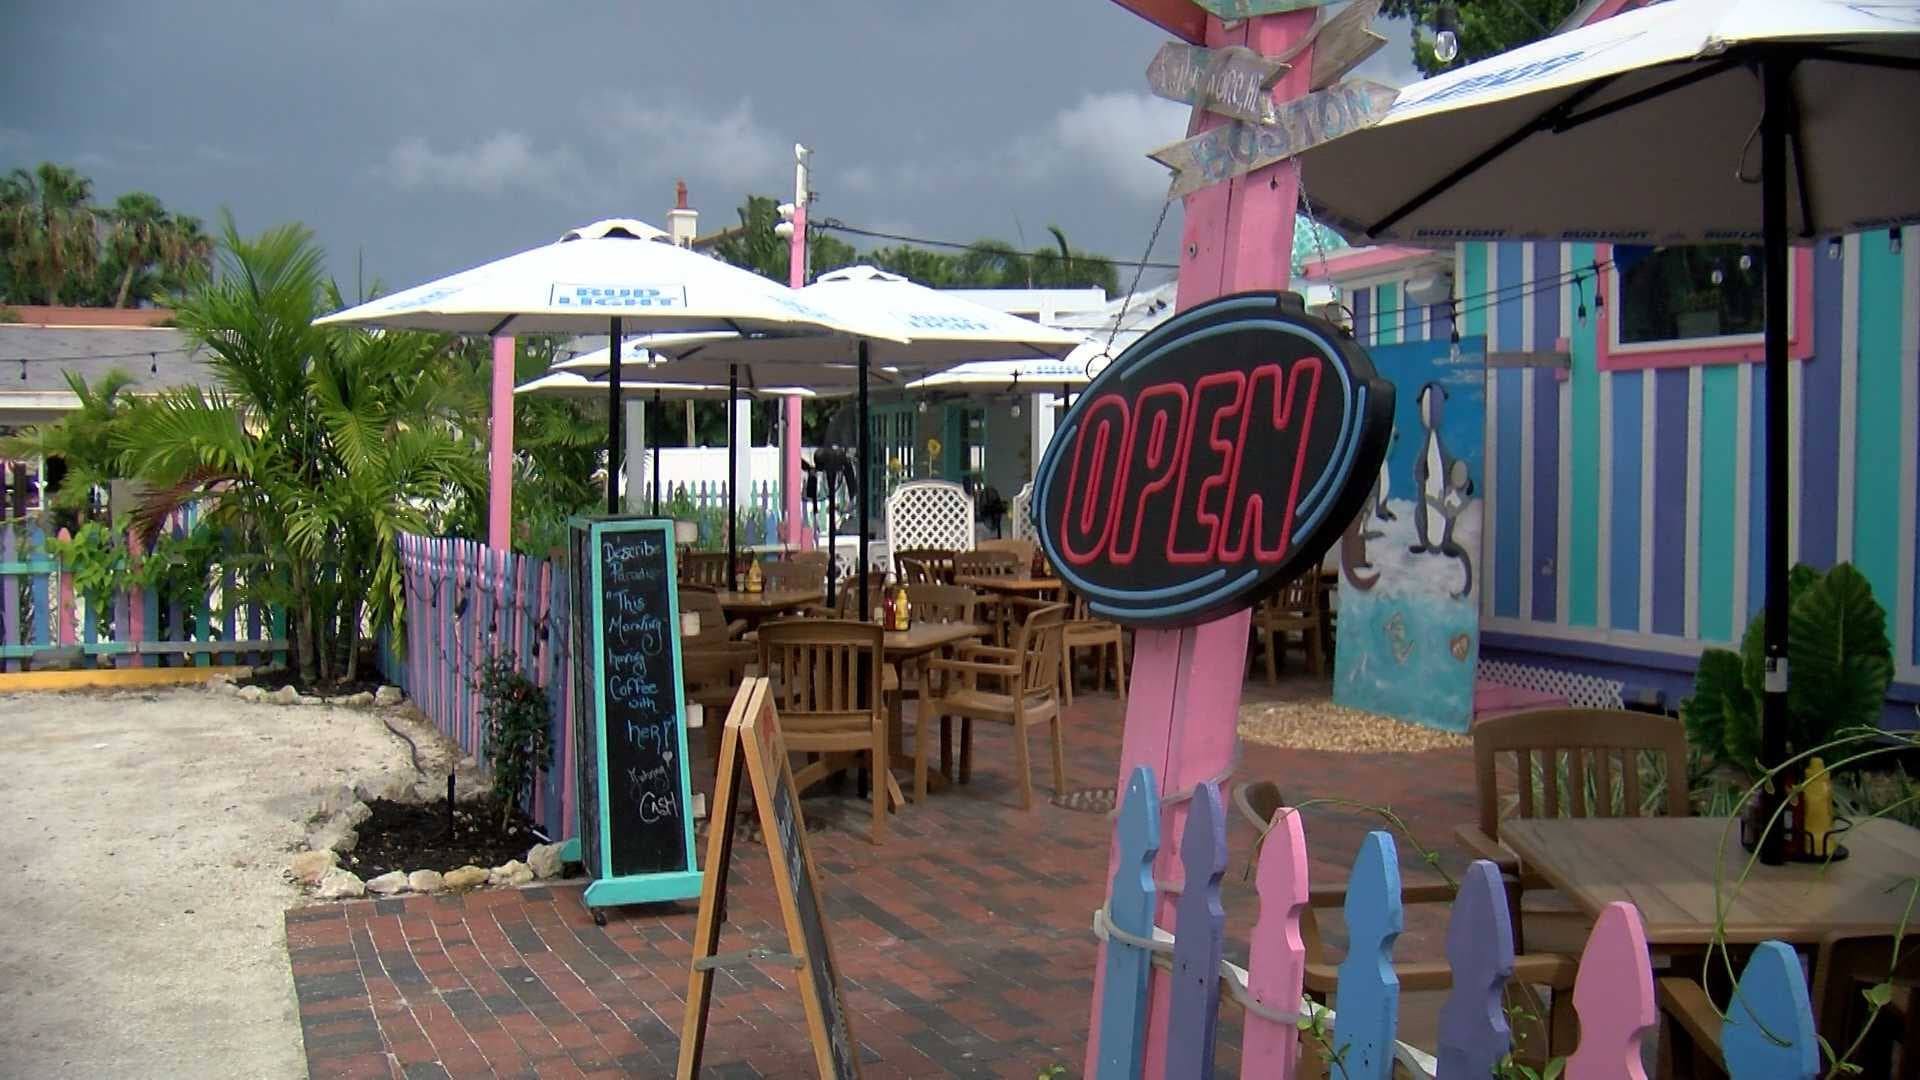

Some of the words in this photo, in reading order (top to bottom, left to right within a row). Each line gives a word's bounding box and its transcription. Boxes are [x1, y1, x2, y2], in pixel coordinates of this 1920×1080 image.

[1191, 85, 1377, 181] BOSTON
[1060, 357, 1323, 565] OPEN
[609, 675, 660, 702] Coffee
